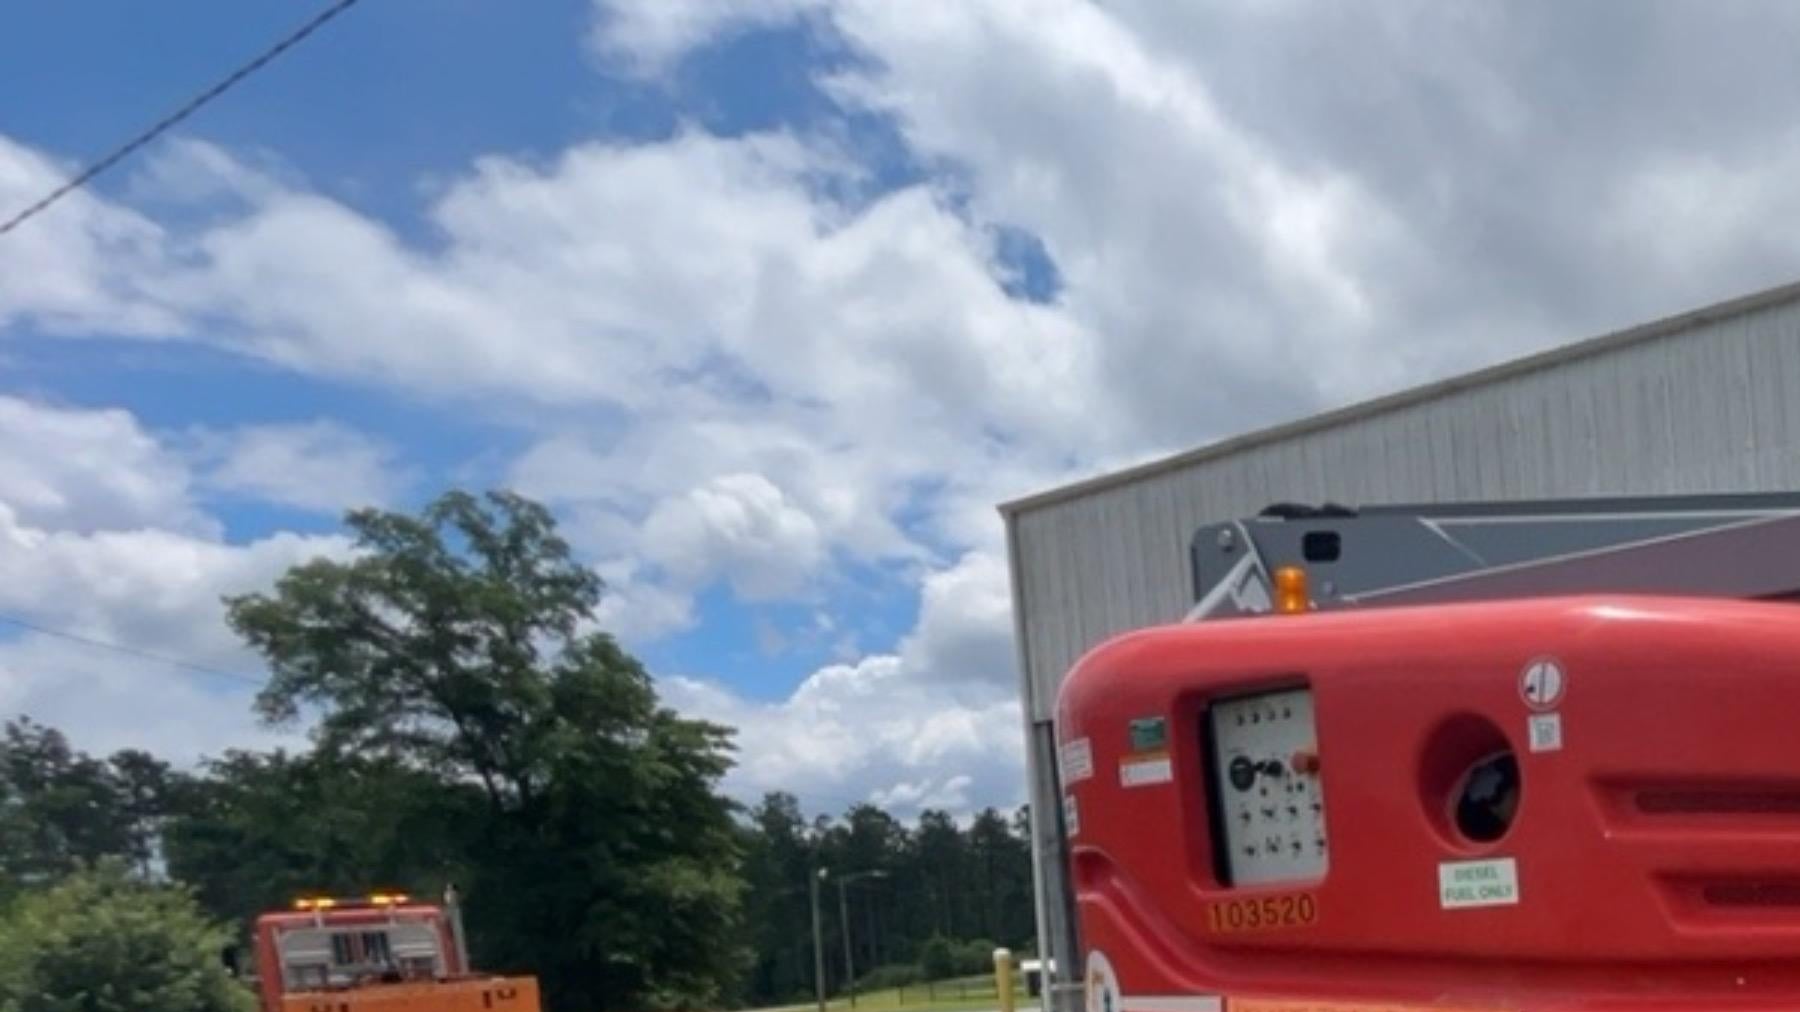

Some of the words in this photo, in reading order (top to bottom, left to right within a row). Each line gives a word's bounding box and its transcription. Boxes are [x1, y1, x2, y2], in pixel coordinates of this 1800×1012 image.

[1445, 886, 1478, 901] FUEL
[1479, 883, 1513, 900] ONLY
[1212, 893, 1315, 932] 103520
